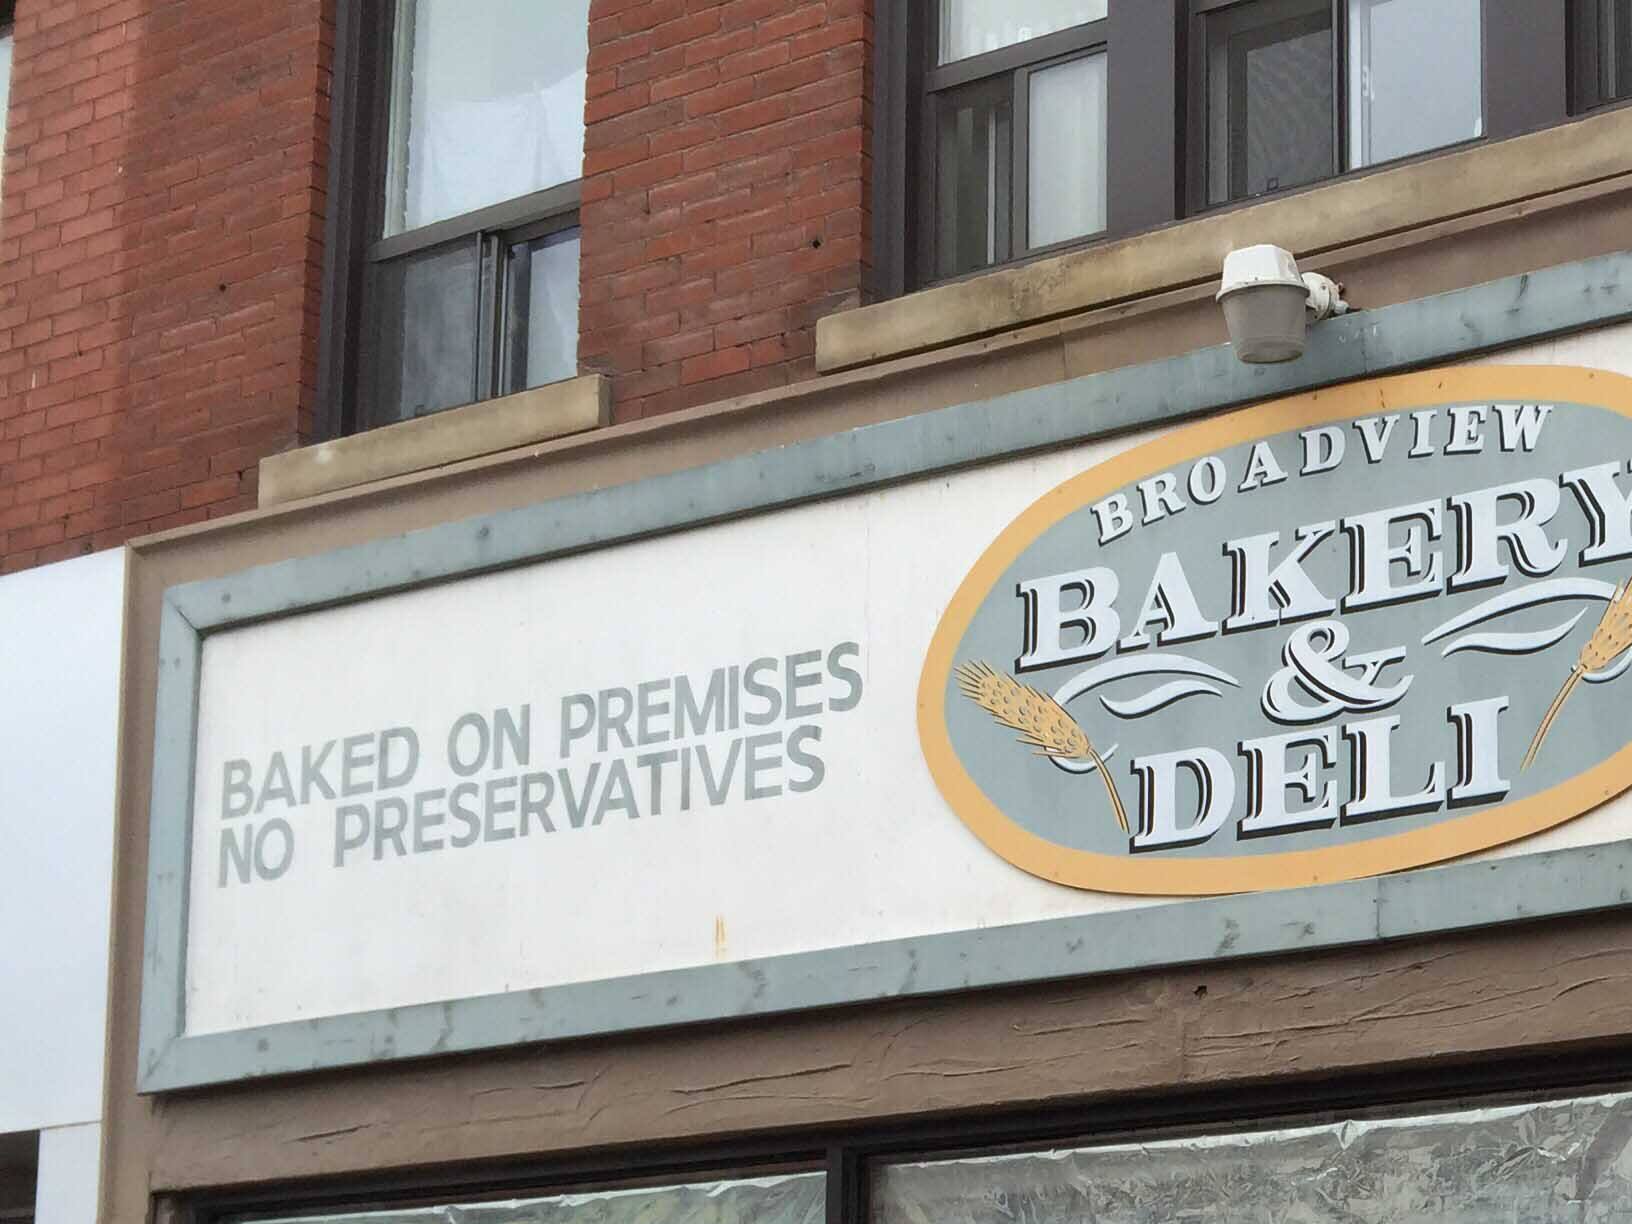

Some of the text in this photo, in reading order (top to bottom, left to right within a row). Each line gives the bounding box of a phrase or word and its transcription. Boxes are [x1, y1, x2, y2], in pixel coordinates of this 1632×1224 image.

[1090, 404, 1555, 546] BROADVIEW
[220, 640, 863, 819] BAKED ON PREMISES
[1260, 619, 1413, 724] &
[218, 725, 825, 887] NO PRESERVATIVES
[1129, 695, 1510, 854] DELI
